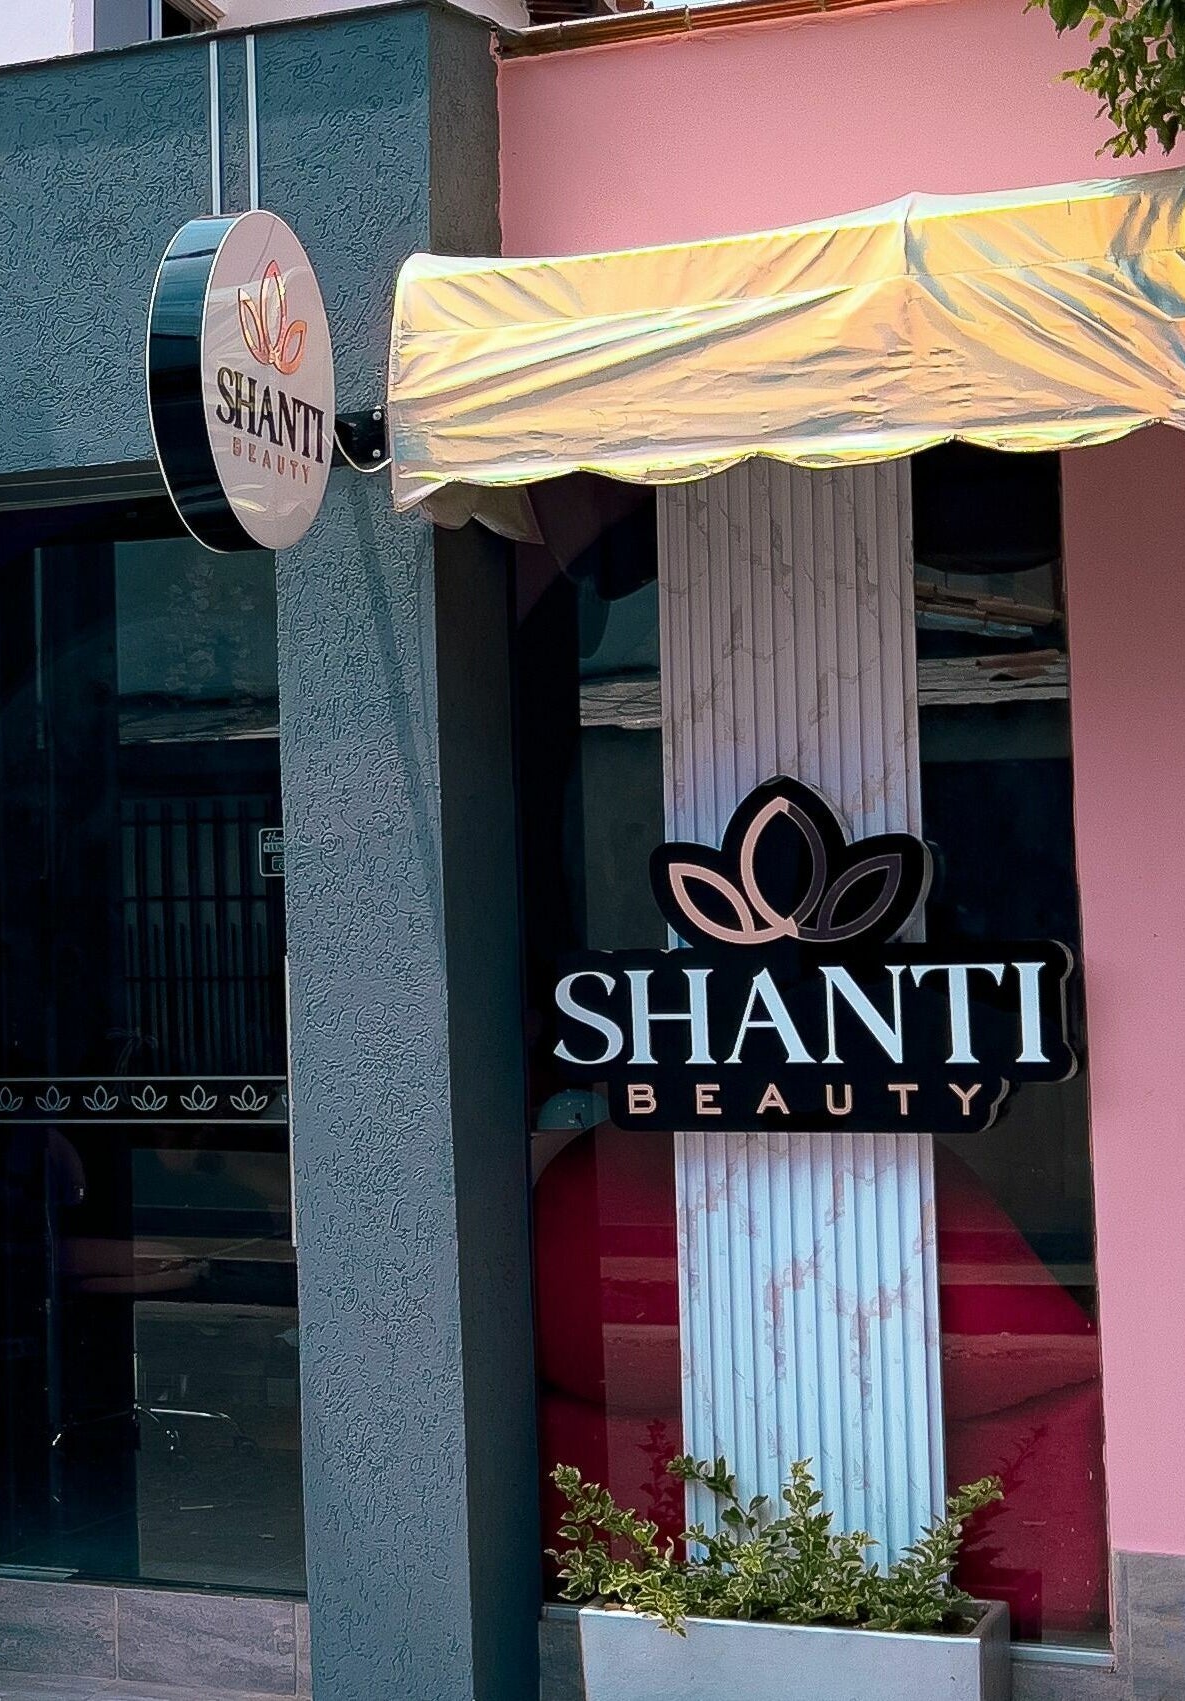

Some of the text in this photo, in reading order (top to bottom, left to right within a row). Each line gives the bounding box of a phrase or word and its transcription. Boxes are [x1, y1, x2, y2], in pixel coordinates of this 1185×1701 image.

[216, 366, 325, 464] SHANTI
[232, 436, 312, 486] BEAUTY
[553, 961, 1051, 1065] SHANTI
[627, 1083, 984, 1116] BEAUTY
